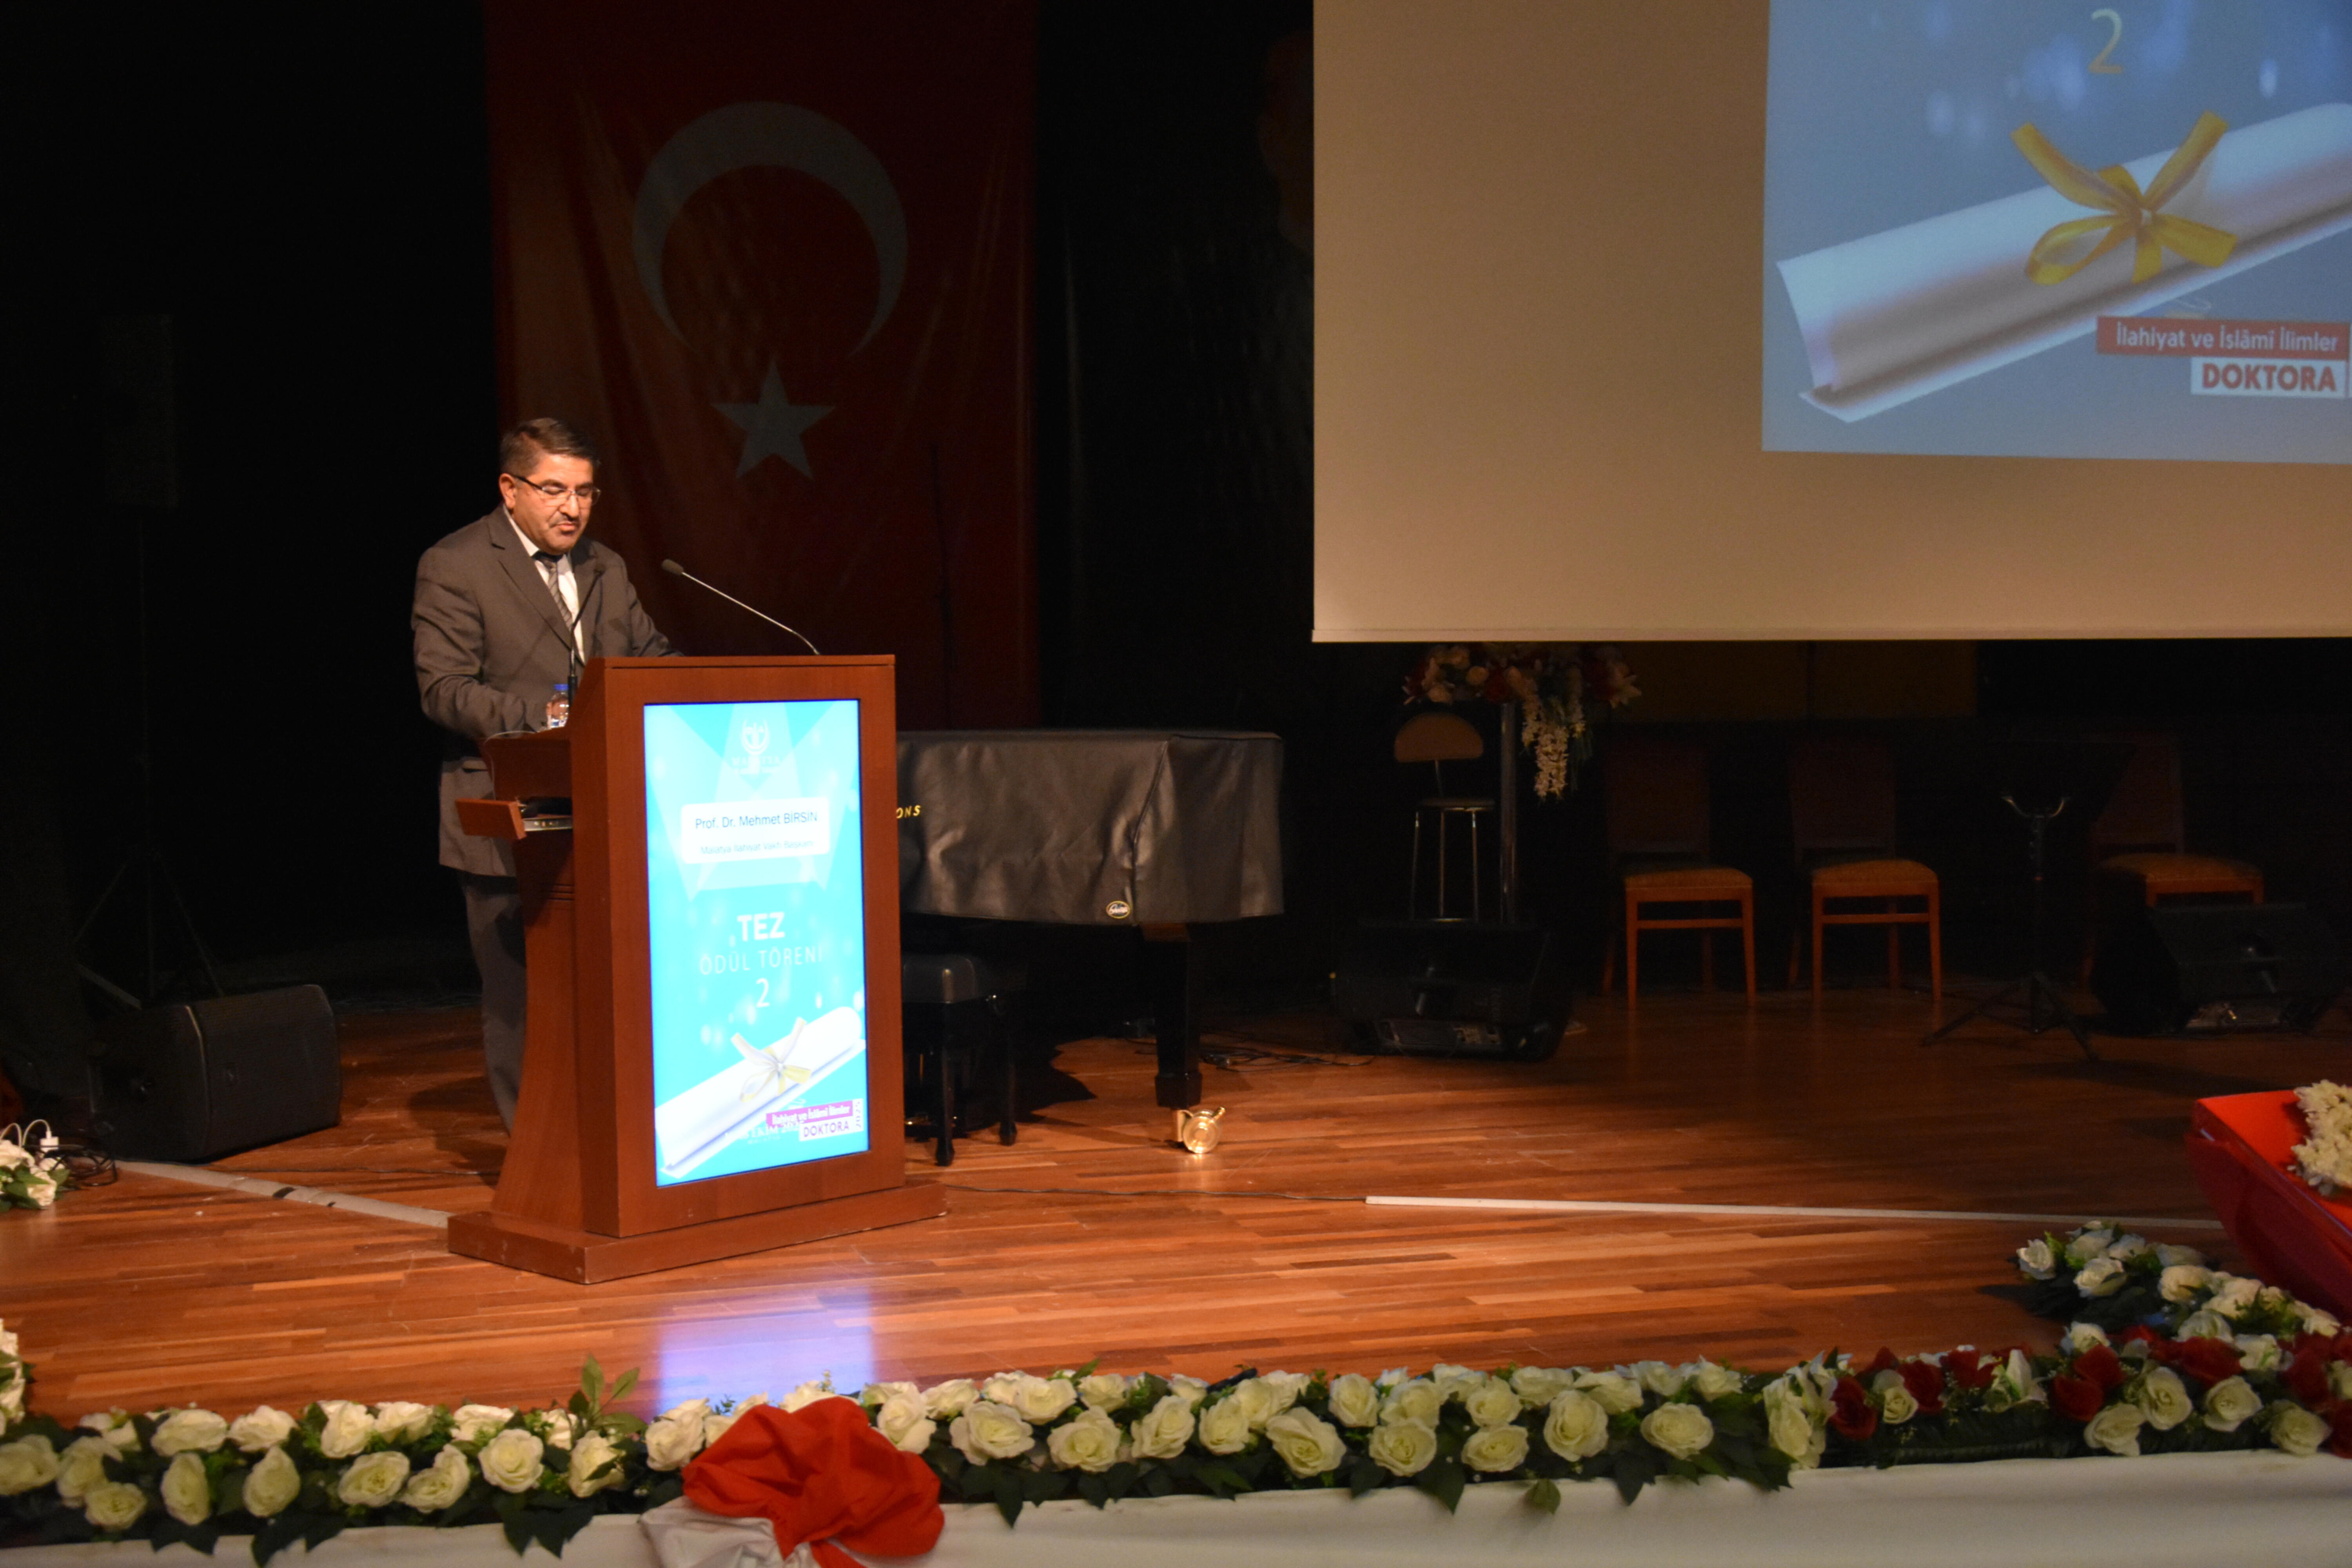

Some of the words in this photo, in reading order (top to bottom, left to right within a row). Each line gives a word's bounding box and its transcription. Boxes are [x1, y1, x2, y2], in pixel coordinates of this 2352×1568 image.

[2088, 8, 2123, 74] 2
[2117, 321, 2186, 351] İlahiyat
[2191, 333, 2214, 348] ve
[2280, 326, 2338, 352] İlimler
[2202, 363, 2337, 392] DOKTORA
[695, 817, 719, 829] Prof.
[722, 817, 736, 828] Dr.
[739, 814, 780, 826] Mehmet
[737, 911, 785, 942] TEZ
[700, 951, 751, 975] ÖDÜL
[756, 978, 770, 1008] 2
[804, 1120, 849, 1138] DOKTORA
